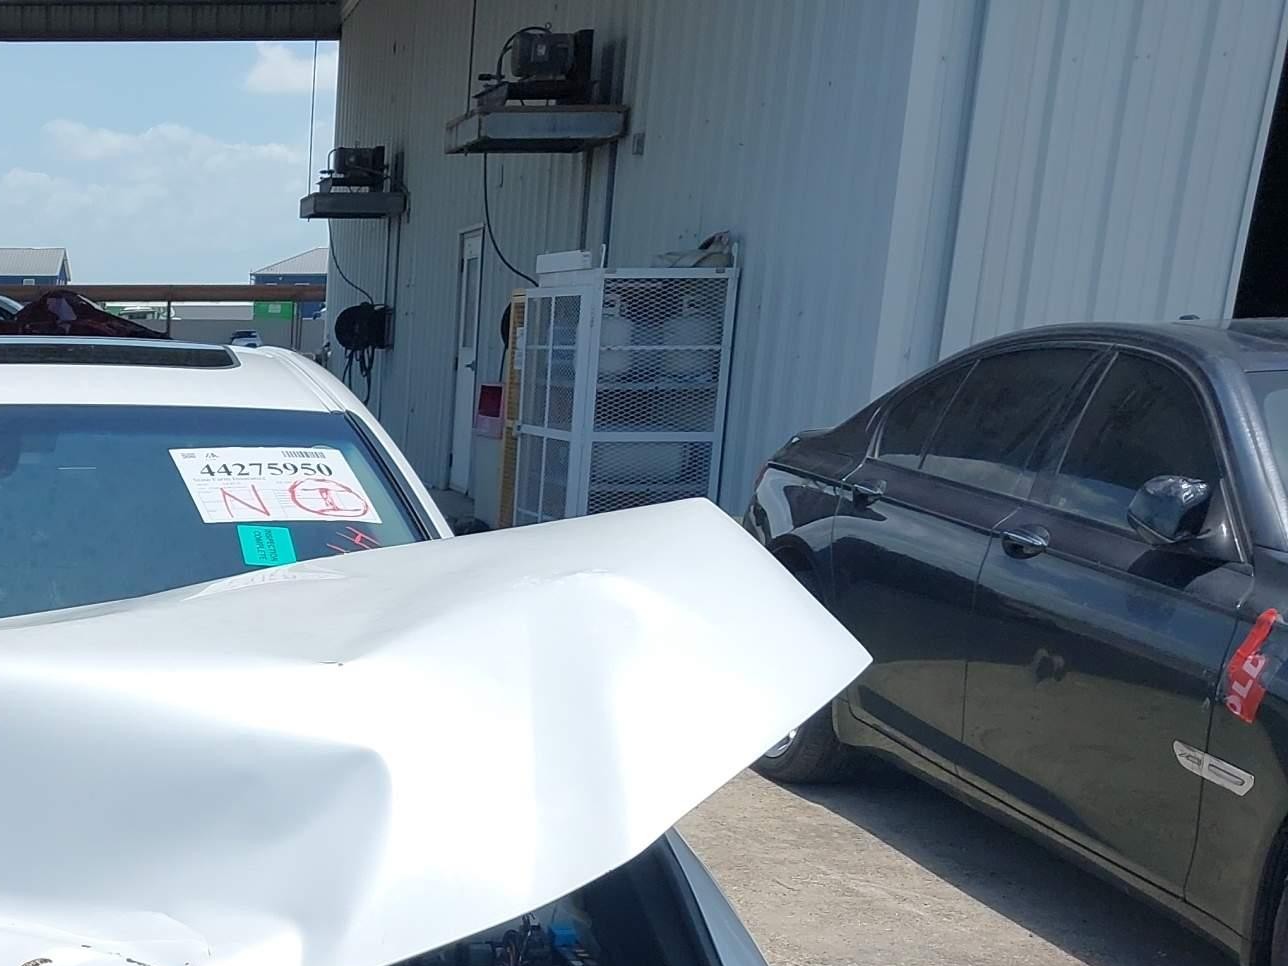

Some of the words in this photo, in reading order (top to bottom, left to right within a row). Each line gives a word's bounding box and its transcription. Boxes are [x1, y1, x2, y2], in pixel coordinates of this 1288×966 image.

[200, 463, 333, 477] 44275950
[220, 484, 270, 518] N
[253, 529, 267, 560] COMPLETE
